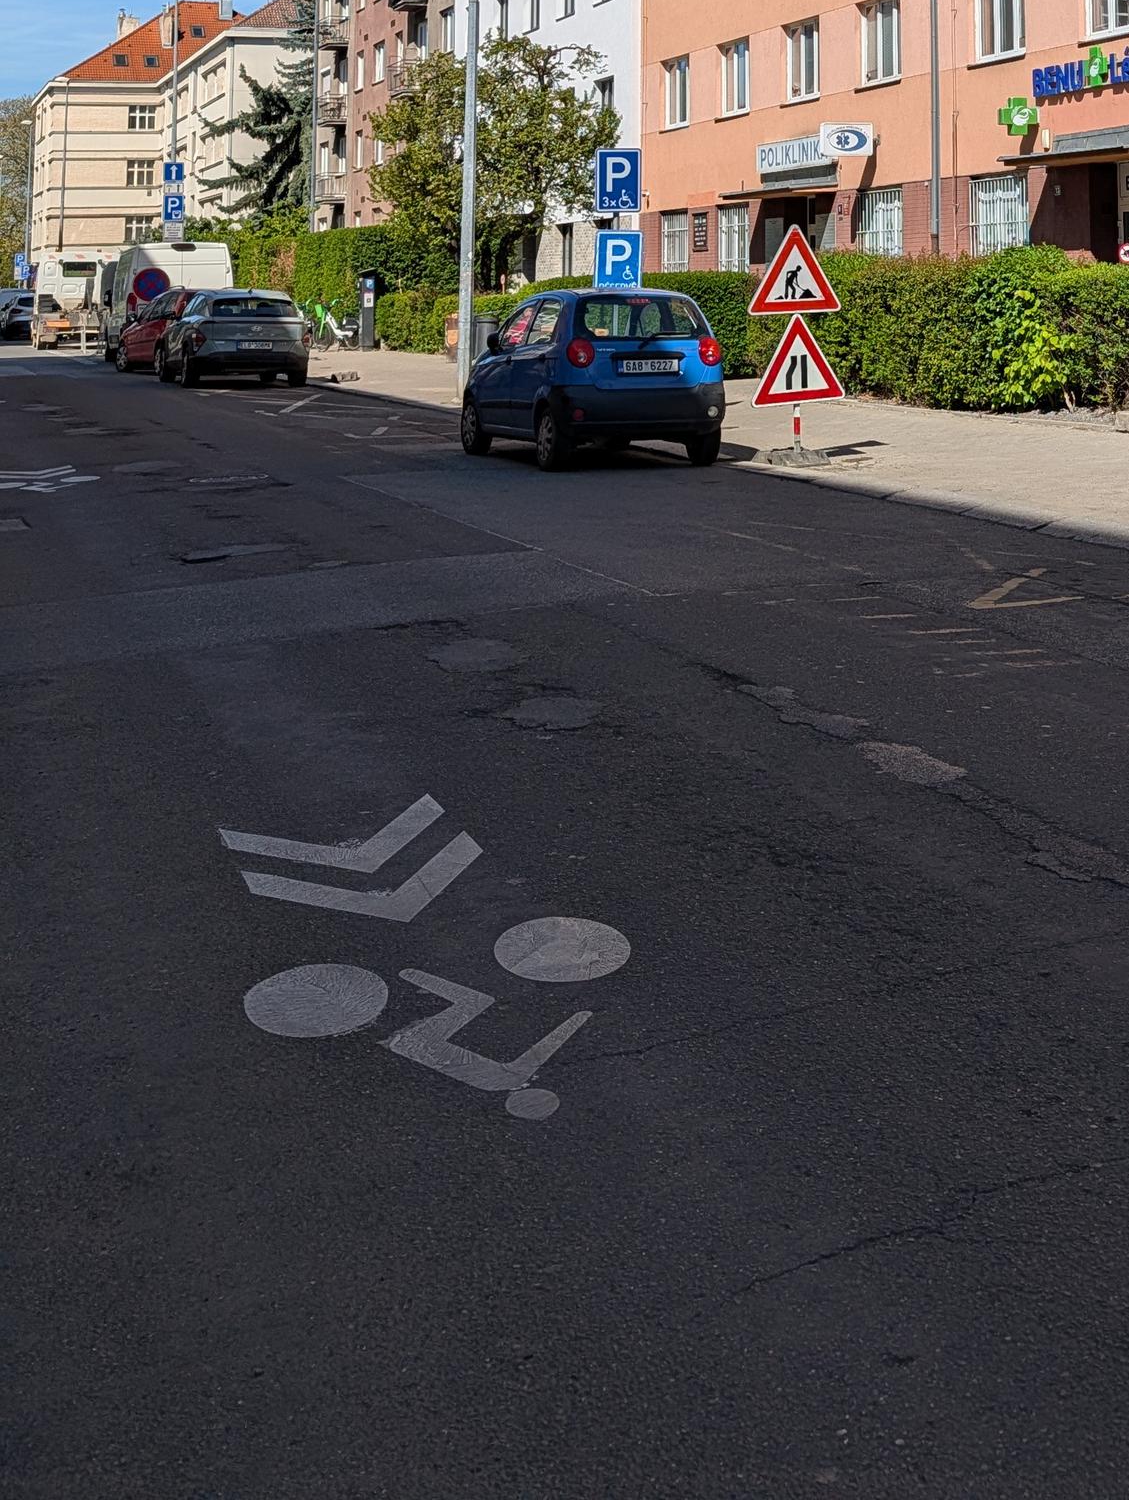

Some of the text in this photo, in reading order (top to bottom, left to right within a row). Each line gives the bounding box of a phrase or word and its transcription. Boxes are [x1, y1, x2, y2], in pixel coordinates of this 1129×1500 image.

[1032, 60, 1084, 97] BENU
[760, 139, 828, 169] POLIKLINIK
[606, 156, 632, 193] P
[167, 197, 180, 213] P
[605, 239, 633, 276] P
[650, 360, 673, 371] 6227
